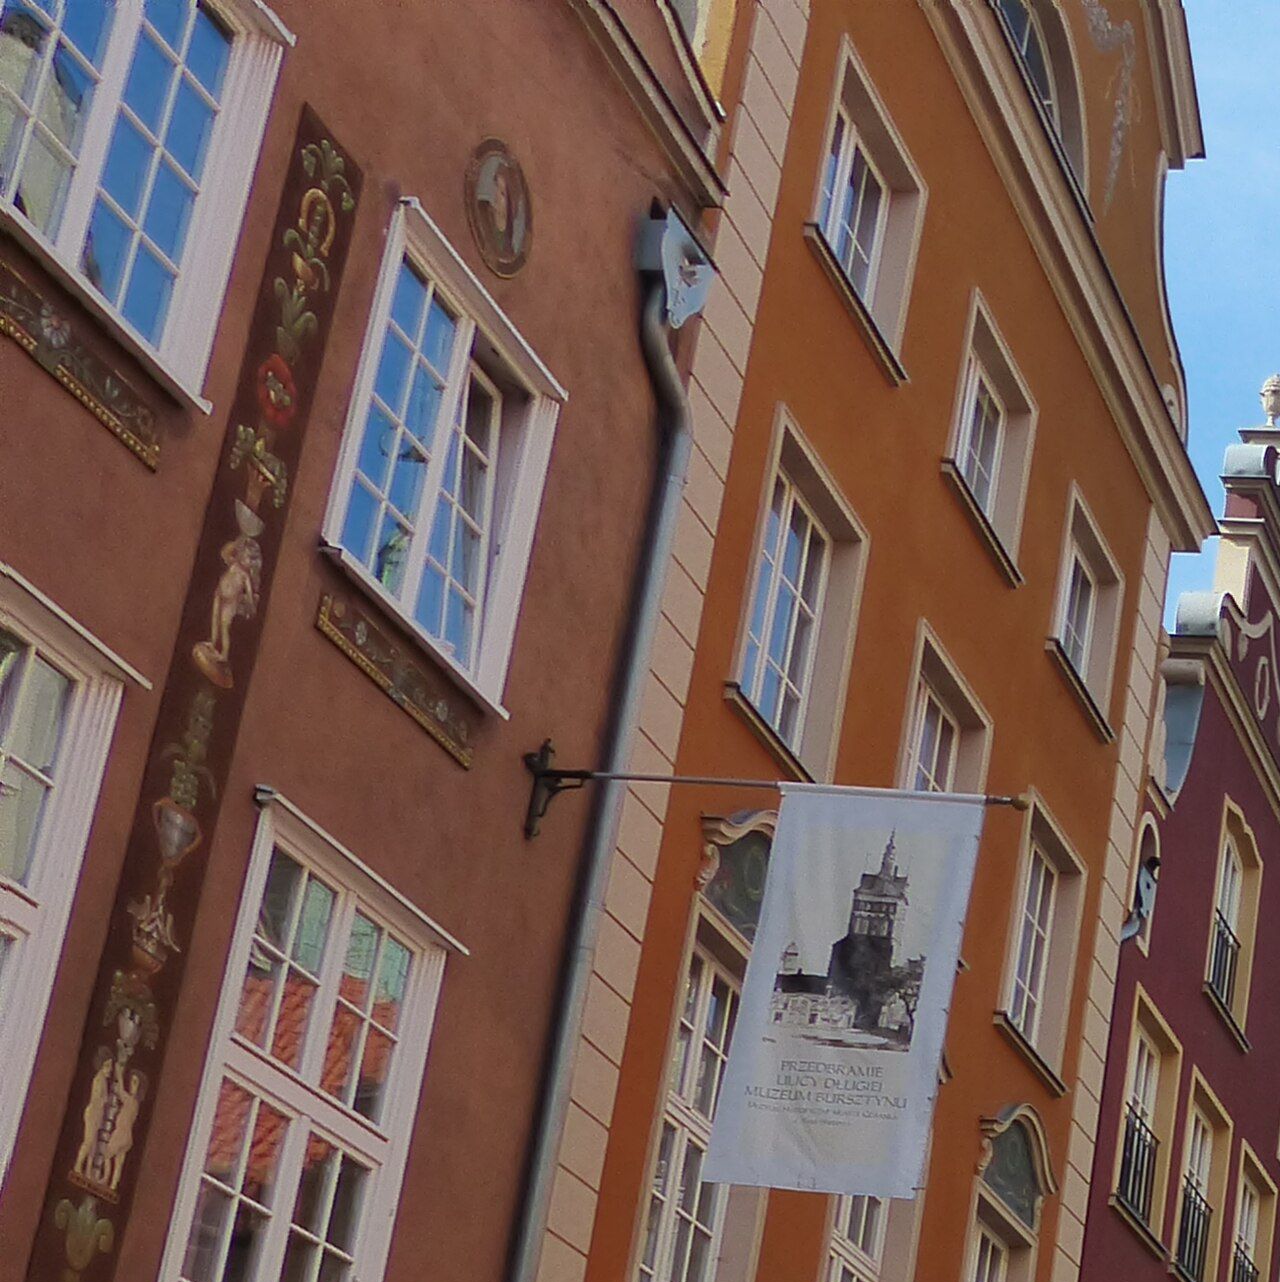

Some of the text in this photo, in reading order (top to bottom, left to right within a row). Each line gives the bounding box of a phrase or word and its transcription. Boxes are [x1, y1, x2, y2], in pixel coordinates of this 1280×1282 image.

[781, 1060, 884, 1078] PRZEDBRAMIE
[777, 1074, 817, 1088] ULICY
[744, 1085, 908, 1109] MUZEUM BURSZTYNU
